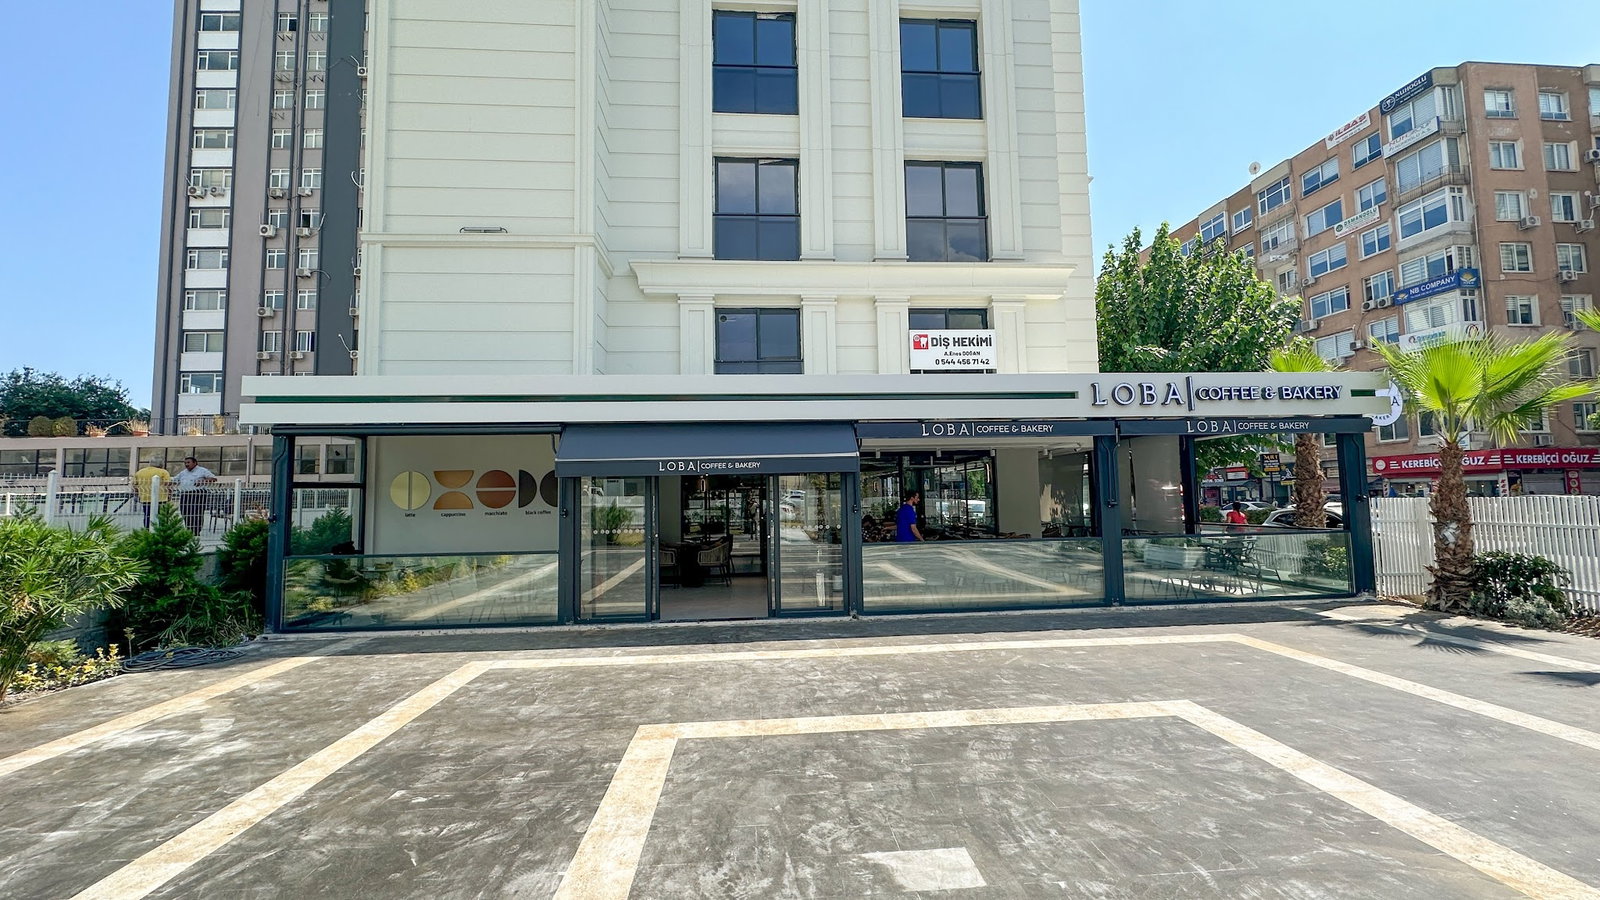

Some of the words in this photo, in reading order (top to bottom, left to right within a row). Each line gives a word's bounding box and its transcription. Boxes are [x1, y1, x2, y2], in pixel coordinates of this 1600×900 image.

[1409, 287, 1420, 295] NB
[1420, 275, 1455, 292] COMPANY
[930, 335, 950, 349] DİŞ
[953, 335, 992, 347] HEKİMİ
[1091, 382, 1185, 406] LOBA
[1195, 386, 1260, 401] COFFEE
[1262, 386, 1277, 400] &
[1278, 385, 1342, 400] BAKERY
[921, 423, 970, 436] LOBA
[976, 425, 1010, 433] COFFEE
[1011, 425, 1019, 433] &
[1021, 424, 1054, 433] BAKERY
[1186, 421, 1232, 433] LOBA
[1238, 422, 1269, 430] COFFEE
[1270, 422, 1277, 430] &
[1279, 422, 1309, 430] BAKERY
[659, 461, 696, 471] LOBA
[1401, 457, 1442, 469] KEREBİÇ
[1461, 455, 1485, 466] ĞUZ
[1516, 452, 1559, 466] KEREBİÇCİ
[1562, 452, 1590, 463] OĞUZ
